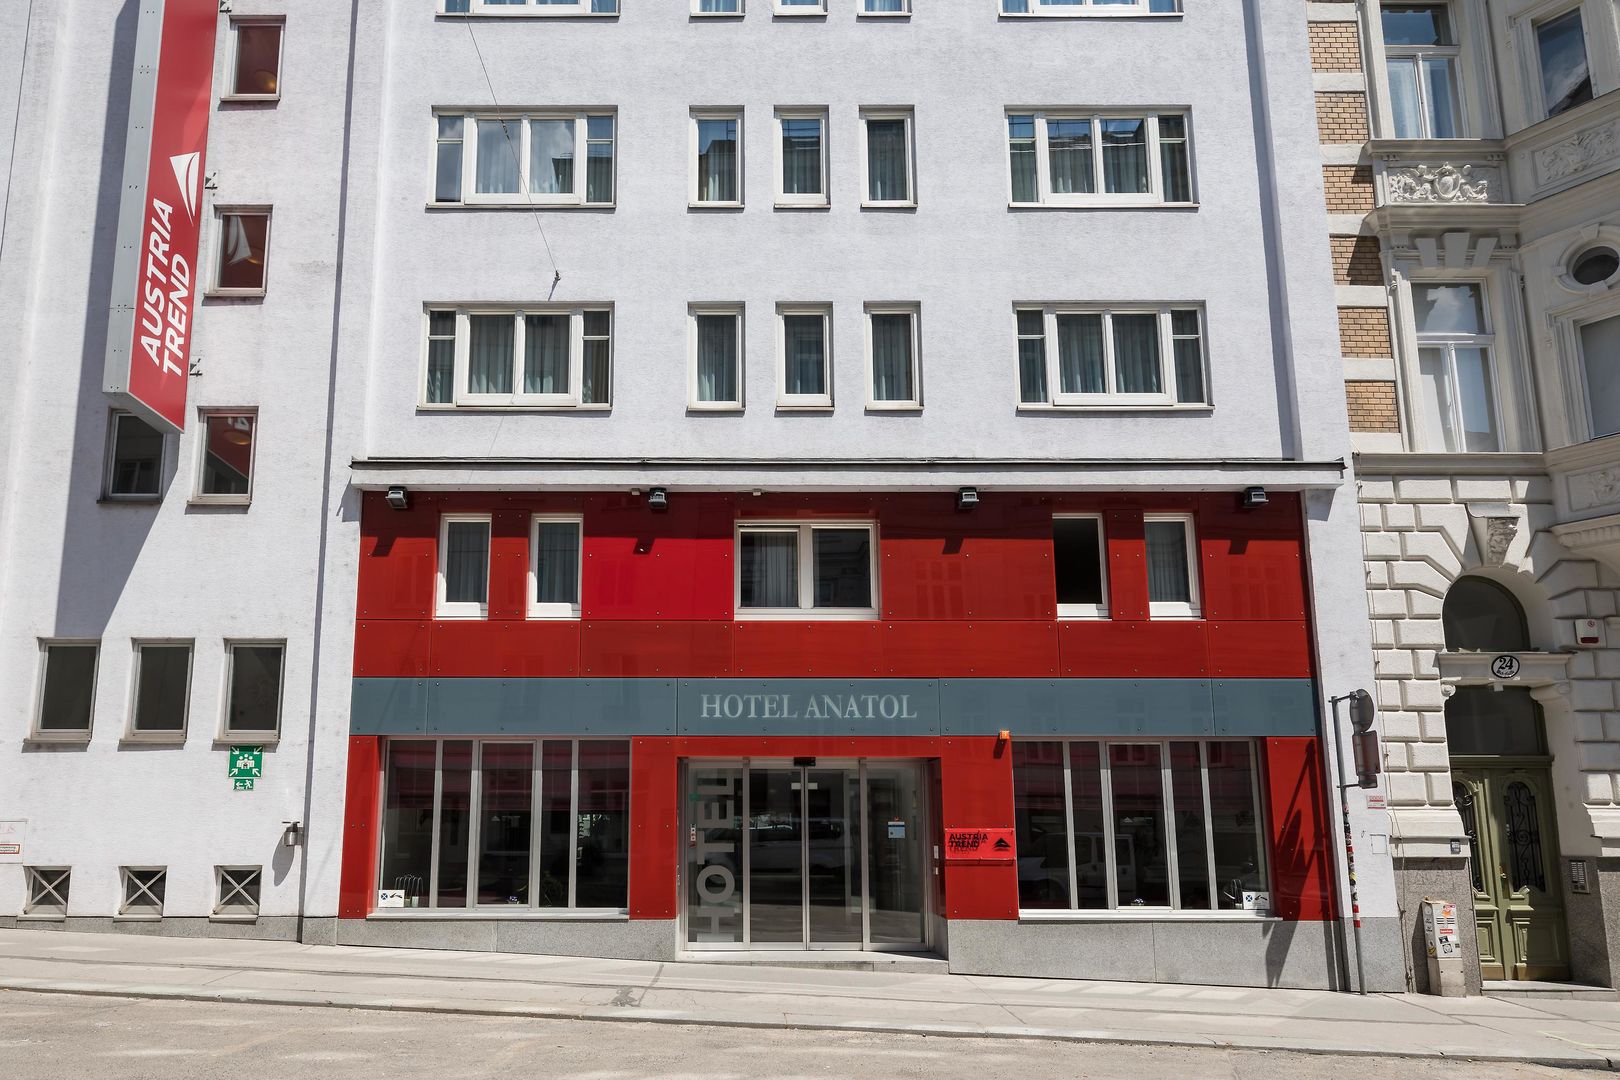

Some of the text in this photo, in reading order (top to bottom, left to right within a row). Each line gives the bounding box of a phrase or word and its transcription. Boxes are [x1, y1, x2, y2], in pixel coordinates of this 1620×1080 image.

[141, 198, 173, 367] AUSTRIA
[163, 253, 190, 377] TREND
[1498, 657, 1514, 670] 24
[700, 694, 918, 719] HOTEL ANATOL
[696, 770, 735, 943] HOTEL
[949, 833, 988, 841] AUSTRIA
